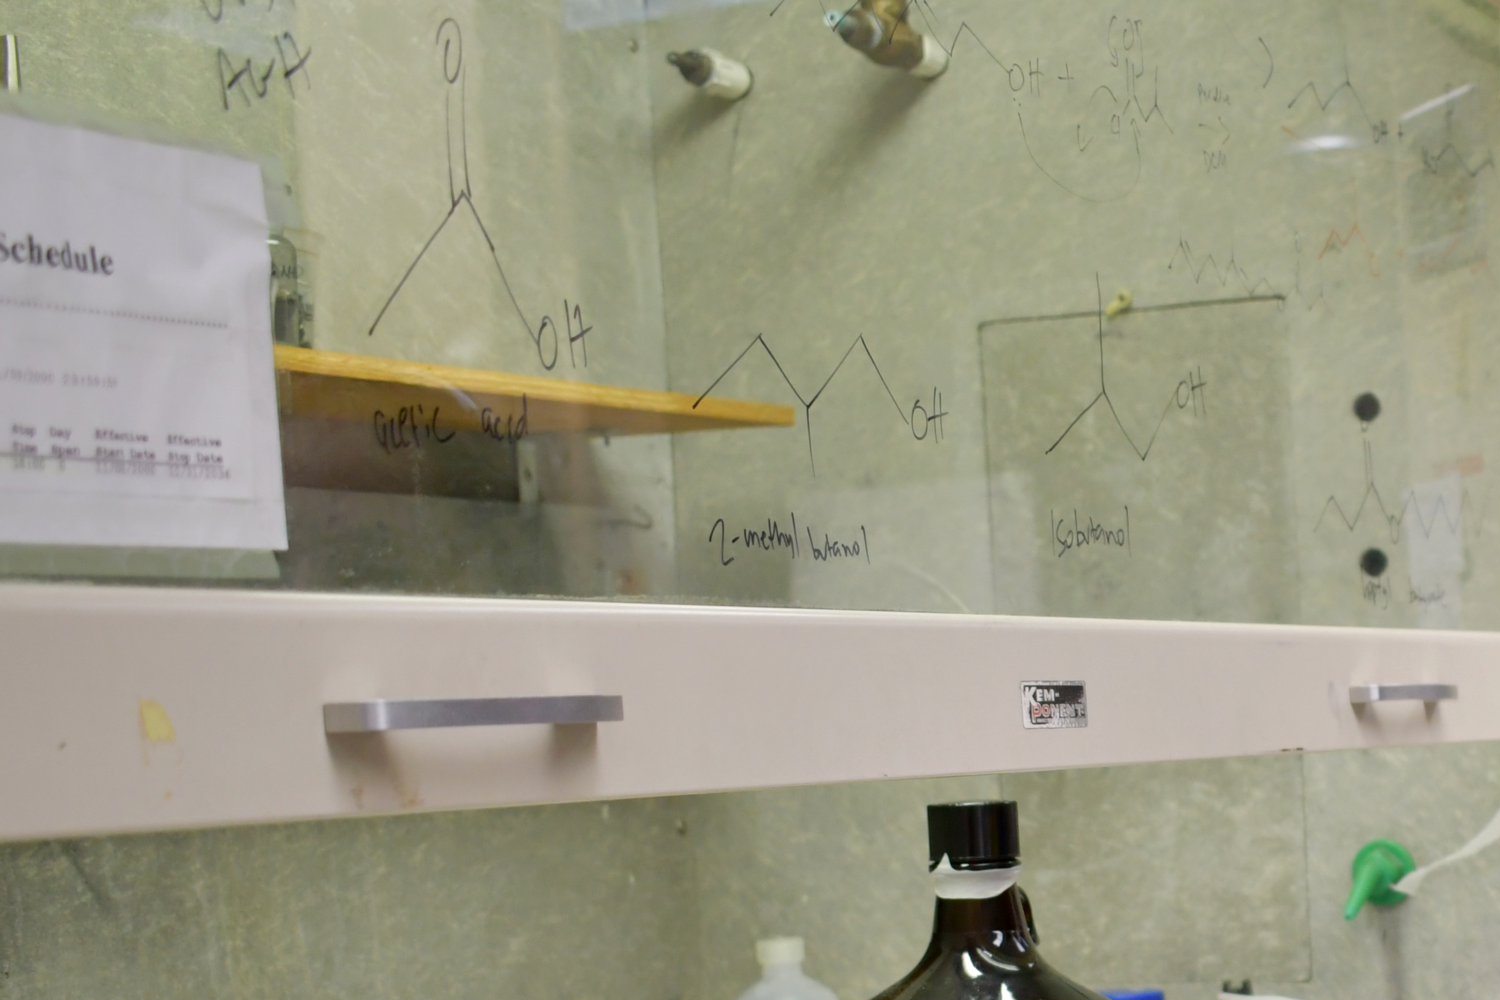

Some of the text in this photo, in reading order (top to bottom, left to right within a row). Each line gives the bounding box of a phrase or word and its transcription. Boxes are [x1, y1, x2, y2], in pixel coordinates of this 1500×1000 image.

[0, 234, 115, 277] Schedule
[537, 298, 593, 371] OH
[911, 386, 949, 443] OH
[1176, 365, 1207, 418] OH
[481, 392, 529, 445] acid
